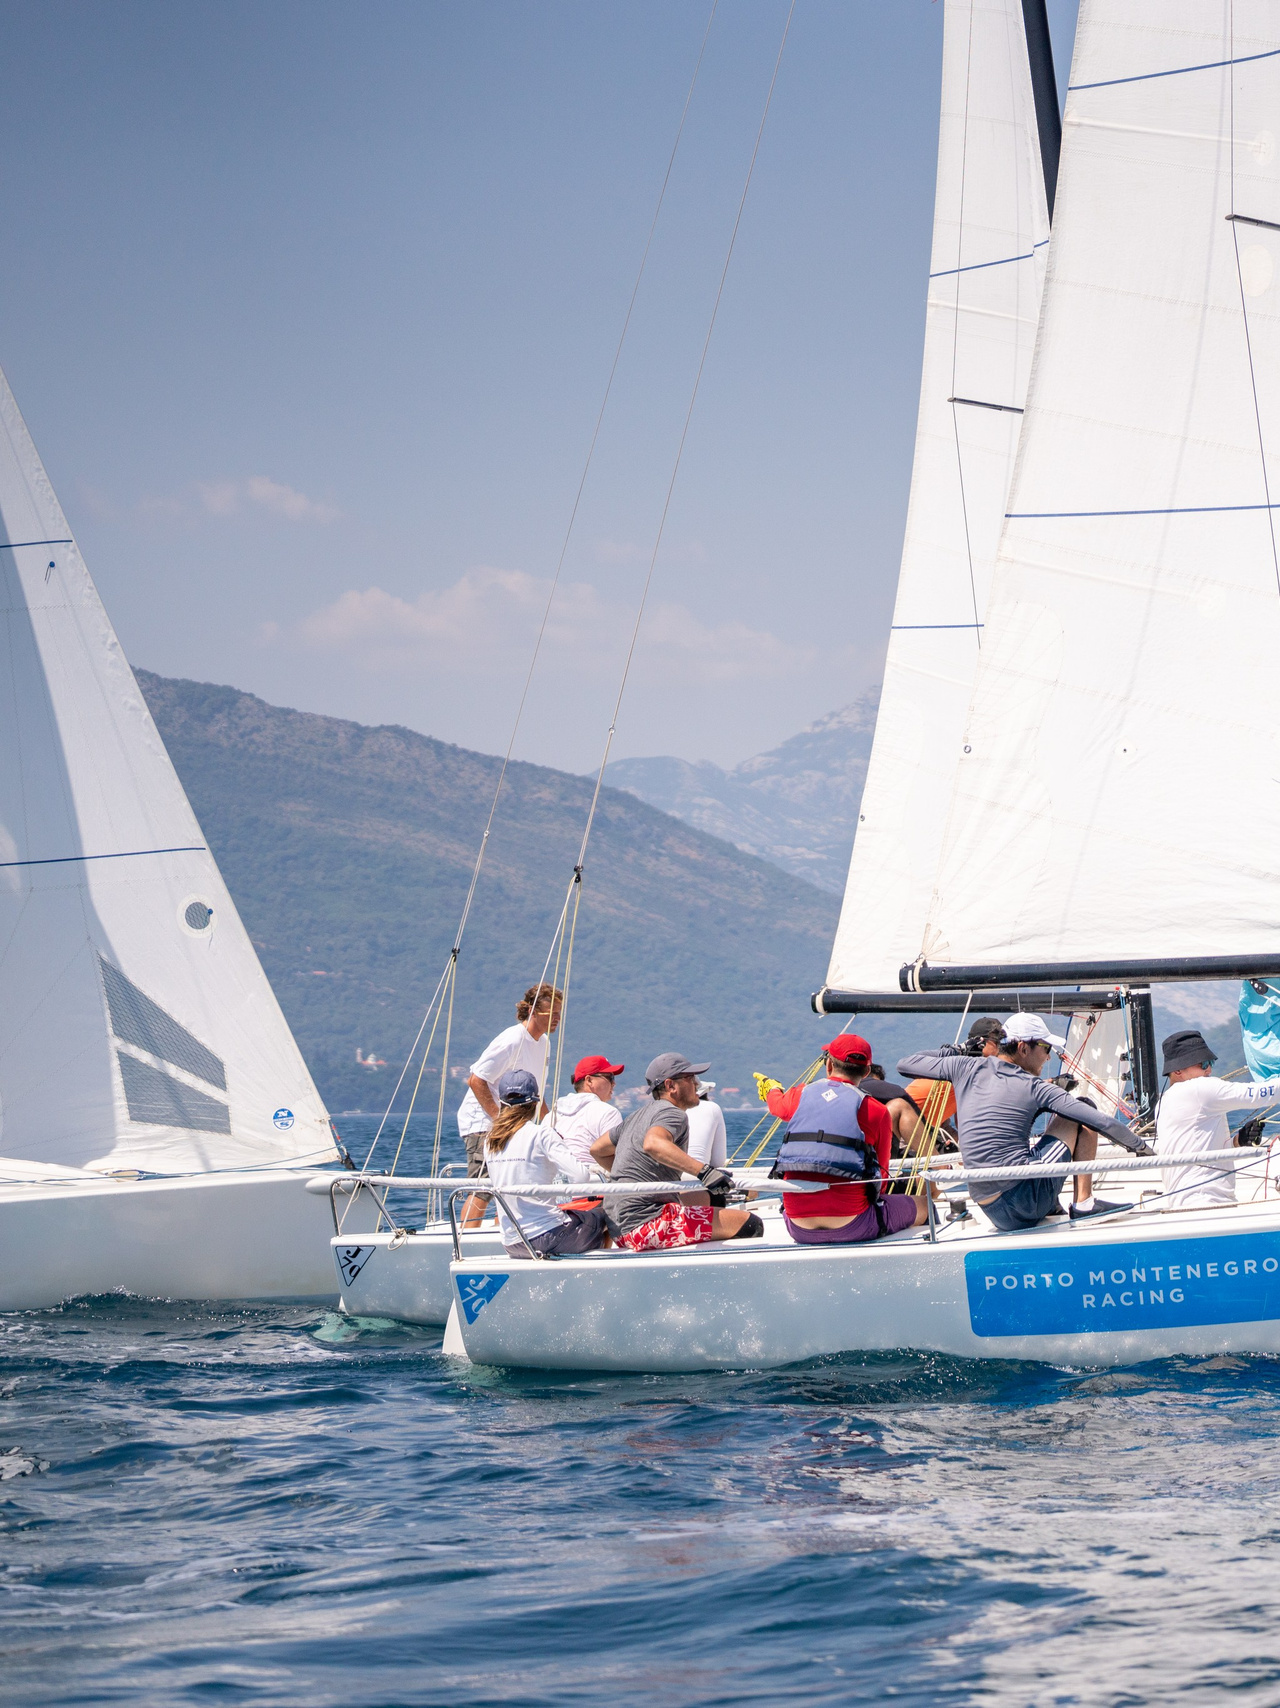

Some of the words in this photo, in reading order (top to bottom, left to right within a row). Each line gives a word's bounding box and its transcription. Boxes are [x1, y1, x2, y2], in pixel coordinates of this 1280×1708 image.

[984, 1272, 1075, 1291] PORTO
[1089, 1257, 1279, 1286] MONTENEGRO
[1082, 1287, 1185, 1309] RACING
